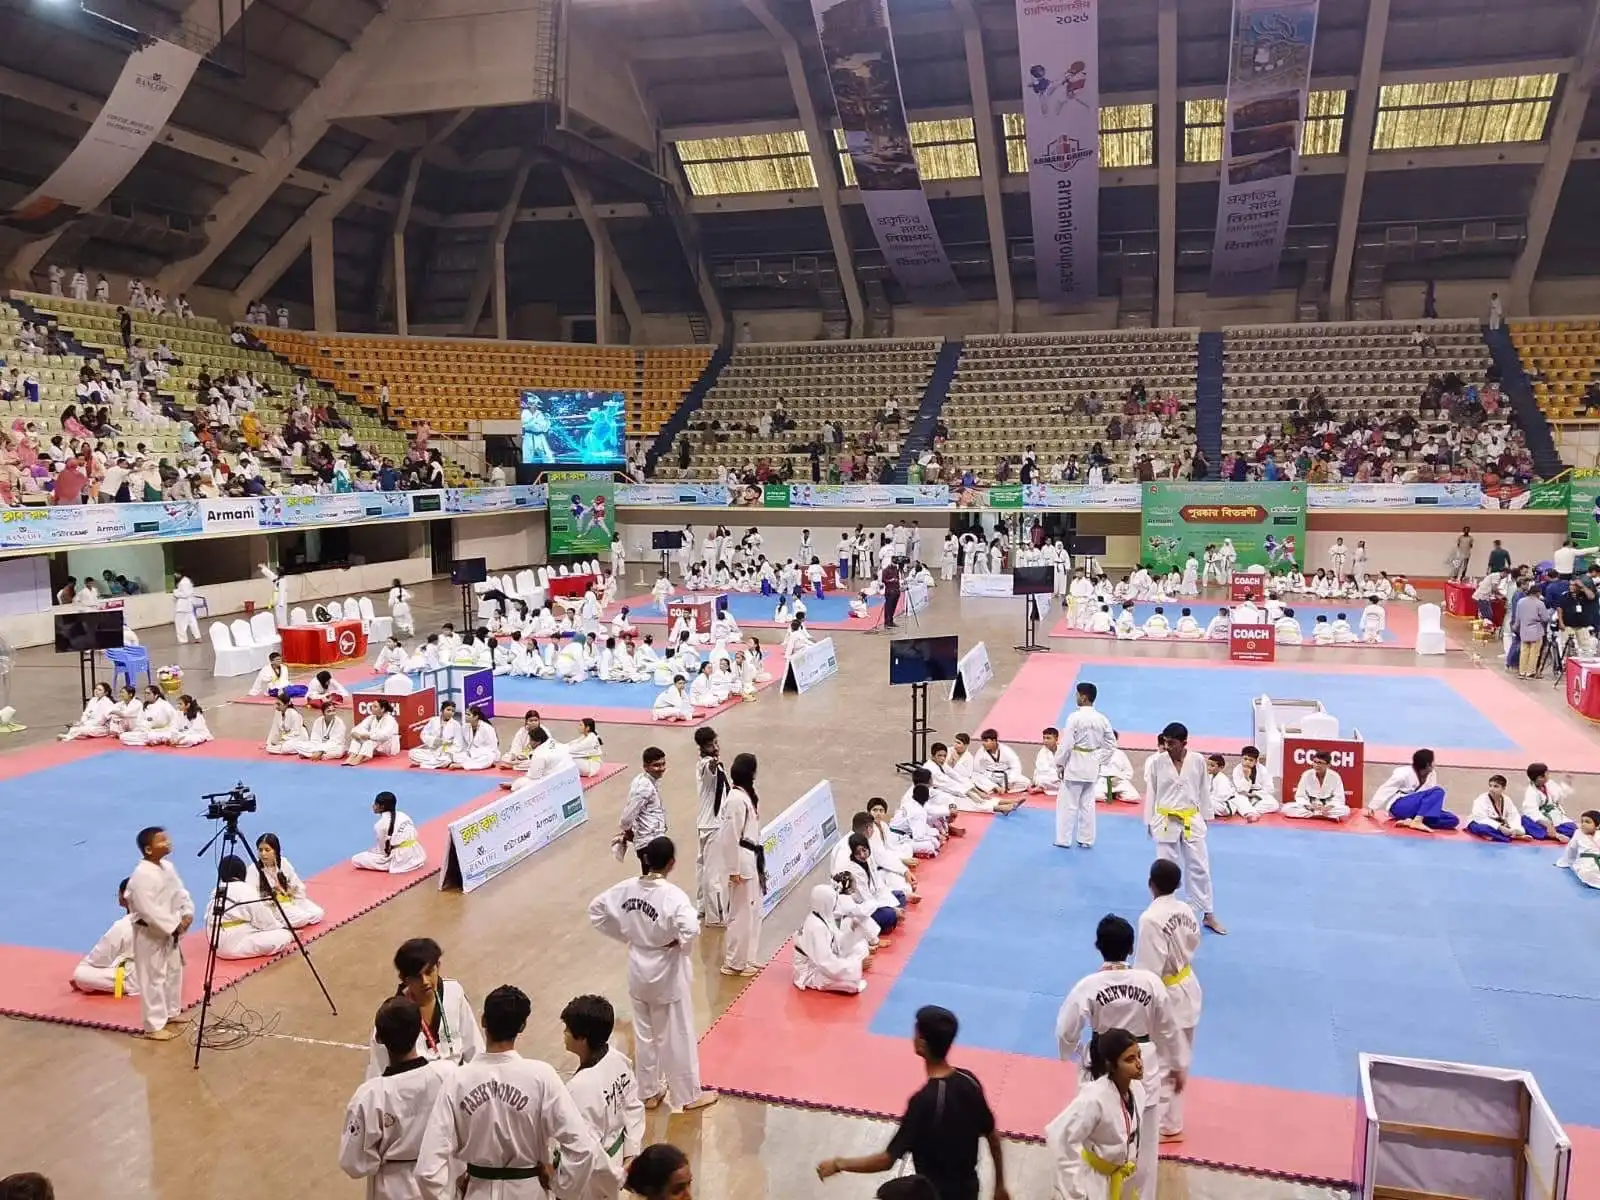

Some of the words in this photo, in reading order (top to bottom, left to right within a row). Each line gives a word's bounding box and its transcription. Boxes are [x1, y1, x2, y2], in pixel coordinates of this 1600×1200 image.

[1033, 154, 1065, 165] ARMANI
[1066, 149, 1094, 161] GROUP
[207, 507, 255, 521] Armani
[96, 523, 126, 532] Armani
[1233, 628, 1269, 639] COACH
[1293, 748, 1354, 767] COCH
[535, 812, 558, 830] Armani
[1095, 984, 1152, 1007] TAEKWONDO
[460, 1079, 530, 1117] TAEKWONDO
